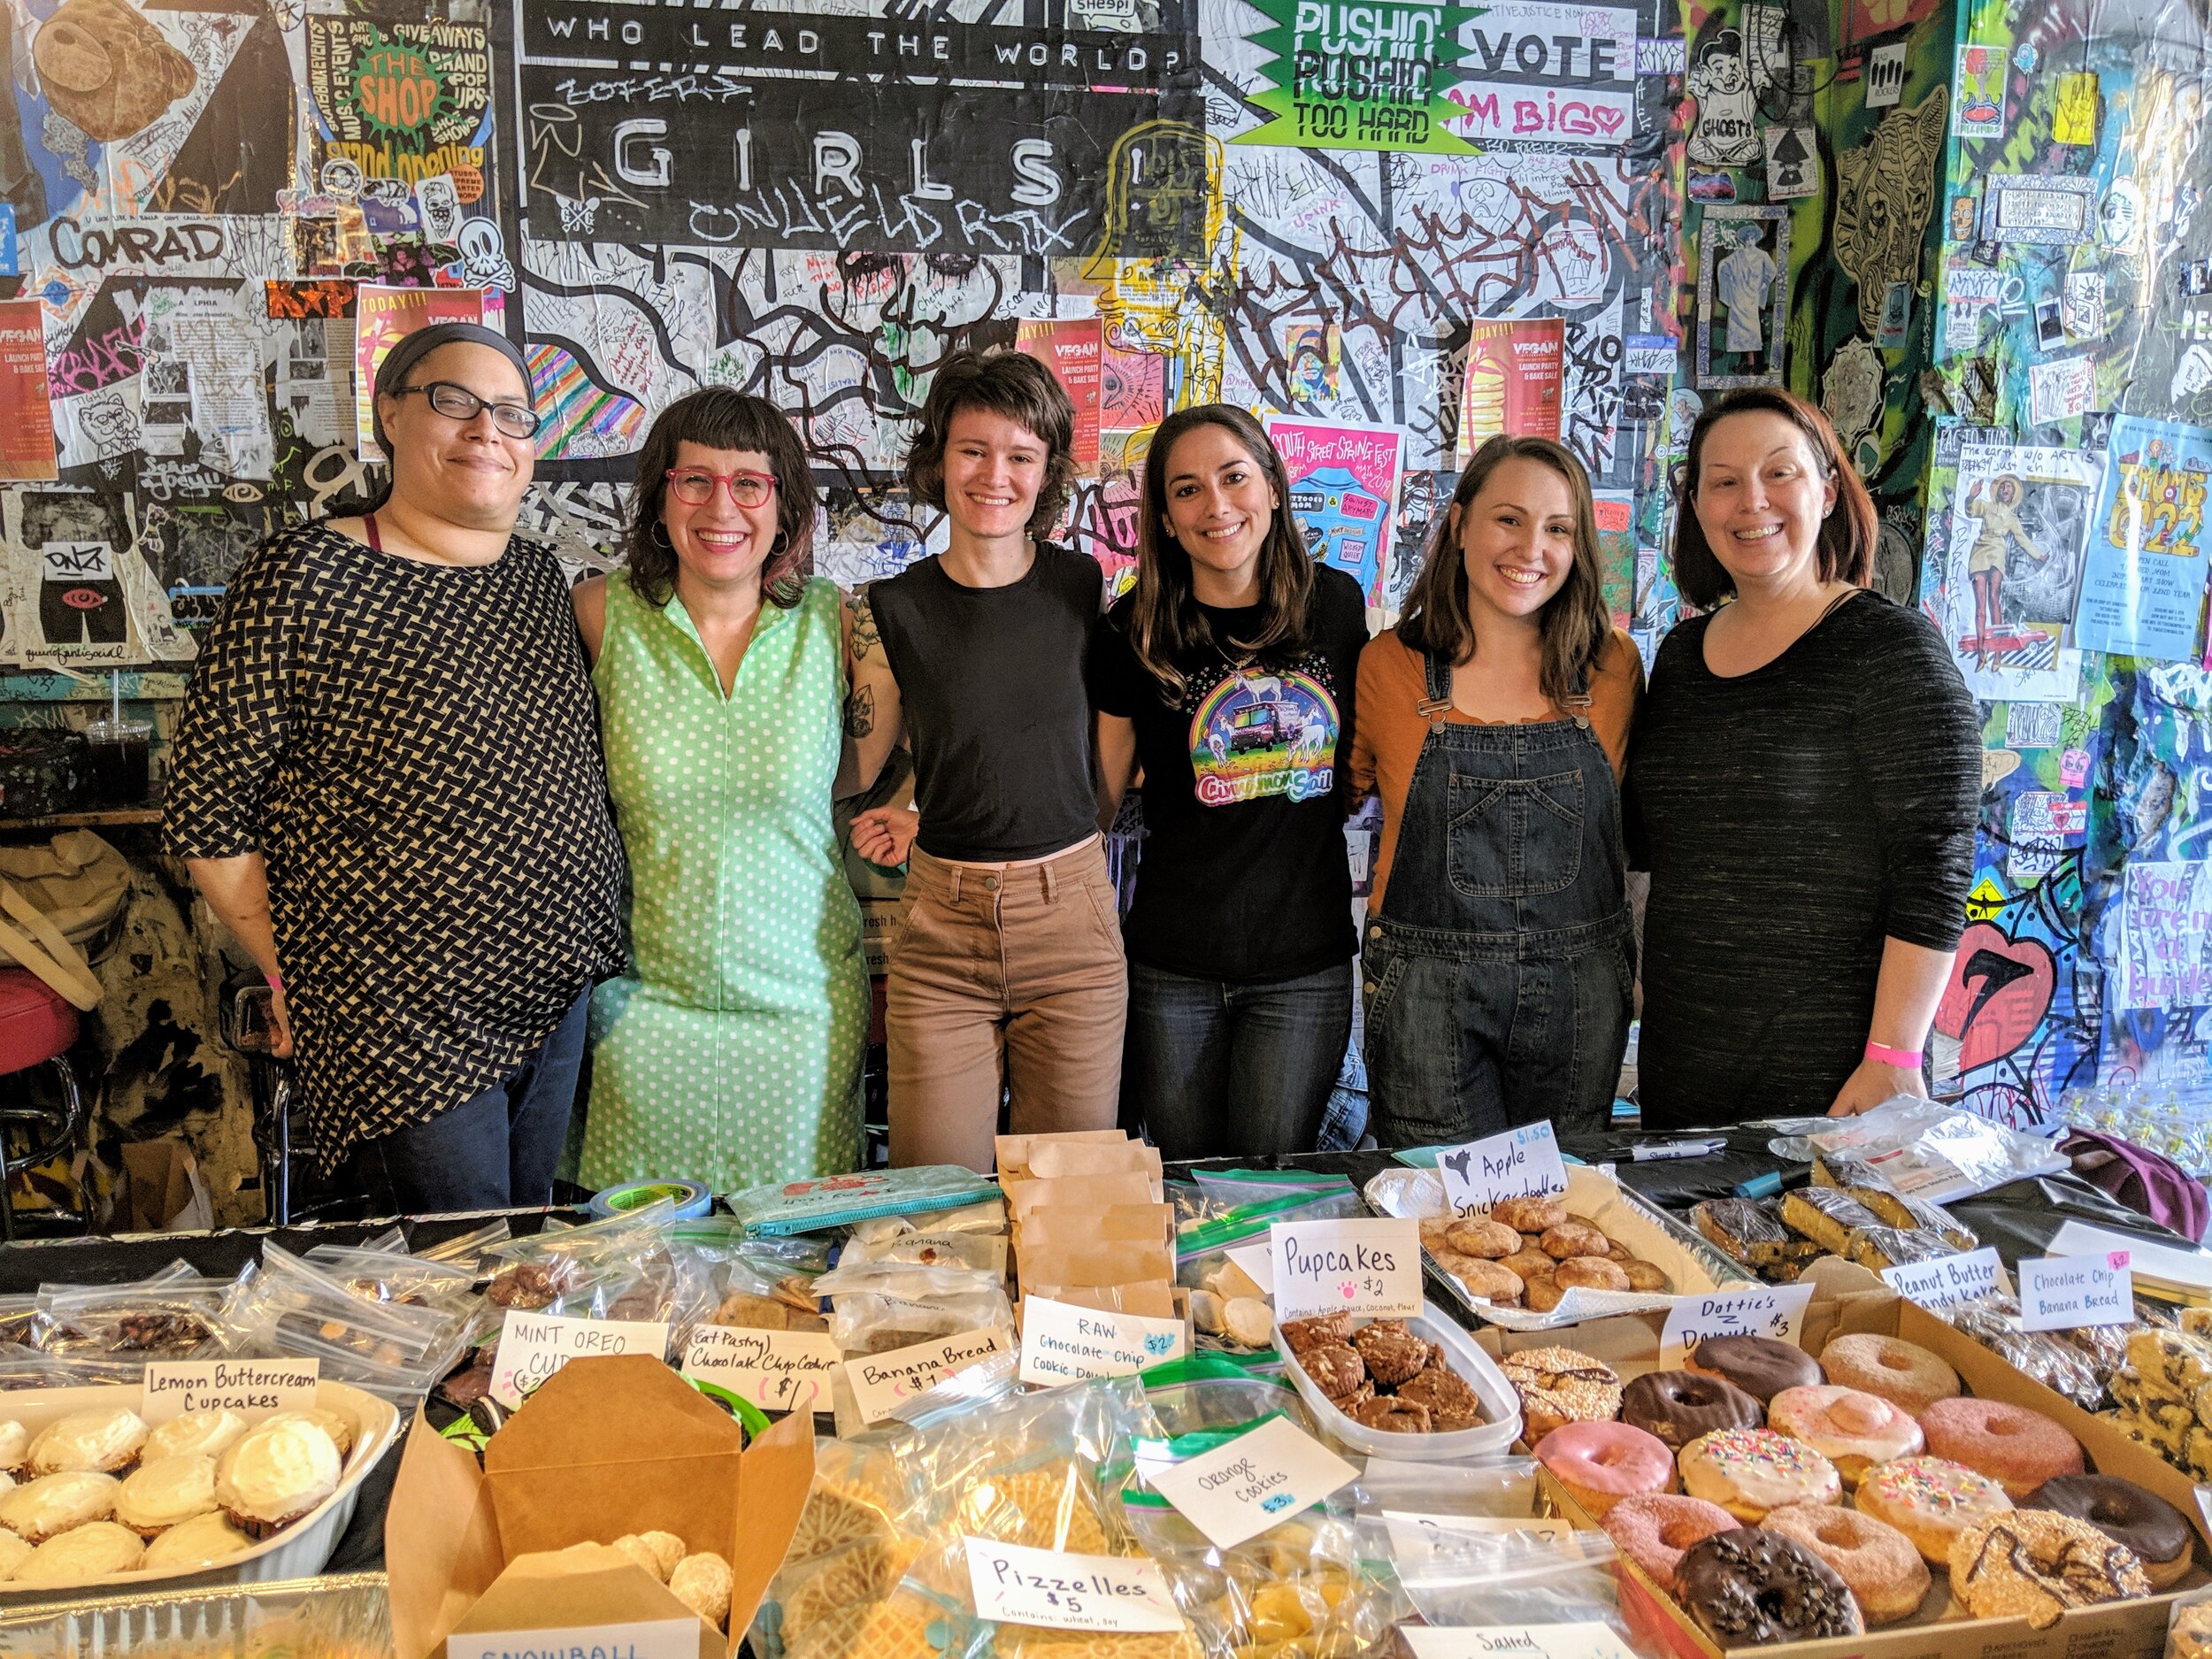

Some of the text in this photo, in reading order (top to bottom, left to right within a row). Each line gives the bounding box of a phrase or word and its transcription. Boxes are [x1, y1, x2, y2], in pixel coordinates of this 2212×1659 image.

[394, 24, 486, 50] GIVEAWAYS
[548, 16, 1179, 77] WHO LEAD THE WORLD?
[369, 53, 427, 77] THE
[1471, 28, 1616, 81] VOTE
[359, 75, 438, 127] SHOP
[1294, 103, 1430, 143] TOO HARD
[362, 292, 427, 314] TODAY!!!
[1056, 343, 1098, 357] VEGAN
[1513, 342, 1557, 354] VEGAN
[1062, 365, 1098, 375] LAUNCH PARTY
[1541, 362, 1557, 371] PARTY
[1307, 439, 1336, 463] STREET
[1337, 434, 1372, 462] SPRING
[1374, 443, 1395, 468] FEST
[2050, 450, 2077, 462] ART
[1483, 1141, 1525, 1179] Apple
[1285, 1236, 1396, 1282] Pupcakes
[1363, 1276, 1384, 1296] $2
[1894, 1263, 1995, 1296] Peanut Butter
[2034, 1270, 2115, 1292] Chocolate Chip
[1701, 1295, 1776, 1317] Dottie's
[2039, 1300, 2079, 1316] Banana
[515, 1325, 626, 1356] MINT OREO
[1079, 1318, 1117, 1339] RAW
[1041, 1334, 1103, 1360] Chocolate
[863, 1337, 998, 1386] Banana Bread
[1033, 1357, 1069, 1377] Cookie
[150, 1363, 316, 1394] Lemon Buttercream
[184, 1393, 279, 1411] Cupcakes
[1235, 1471, 1289, 1503] Cookies
[992, 1559, 1148, 1596] Pizzelles
